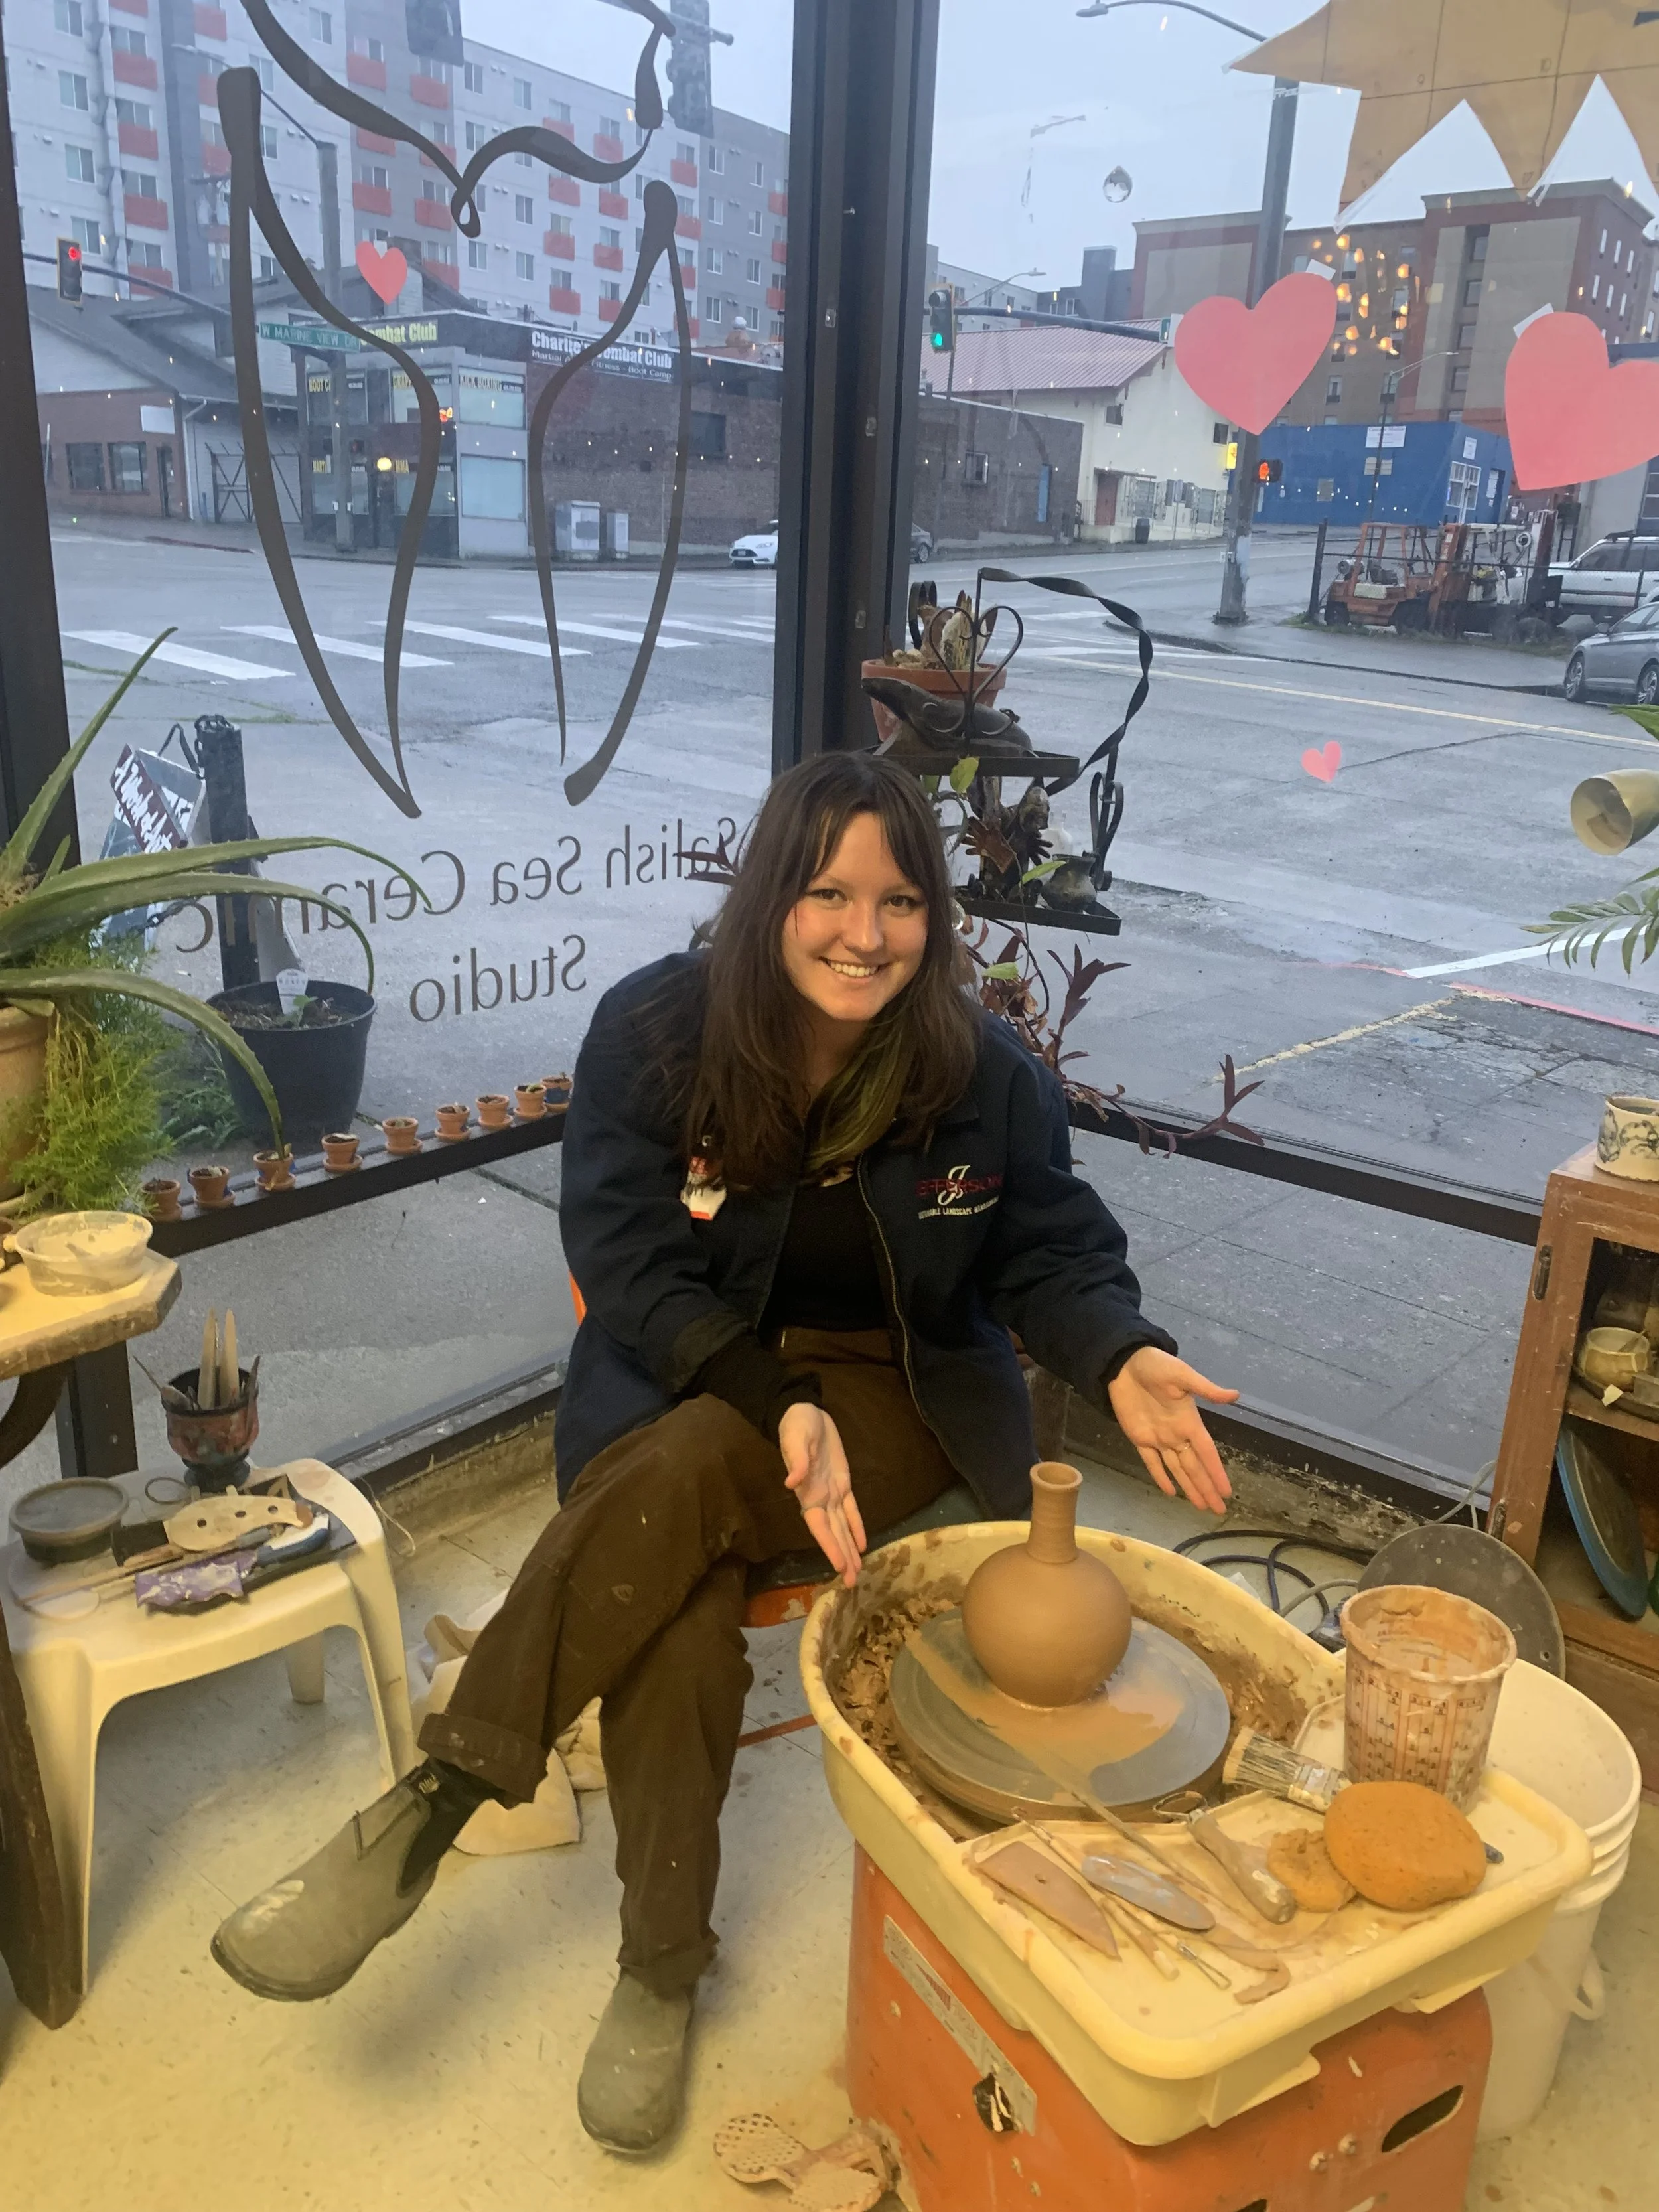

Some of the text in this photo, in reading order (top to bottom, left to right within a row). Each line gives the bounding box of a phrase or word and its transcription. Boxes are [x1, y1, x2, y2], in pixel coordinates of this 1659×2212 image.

[261, 324, 358, 348] W MARINE VIEW DR
[409, 321, 437, 342] Club
[532, 331, 672, 370] Charlie' ombat Club
[532, 350, 563, 362] Martial
[628, 366, 647, 376] Boot
[649, 368, 672, 380] Camp
